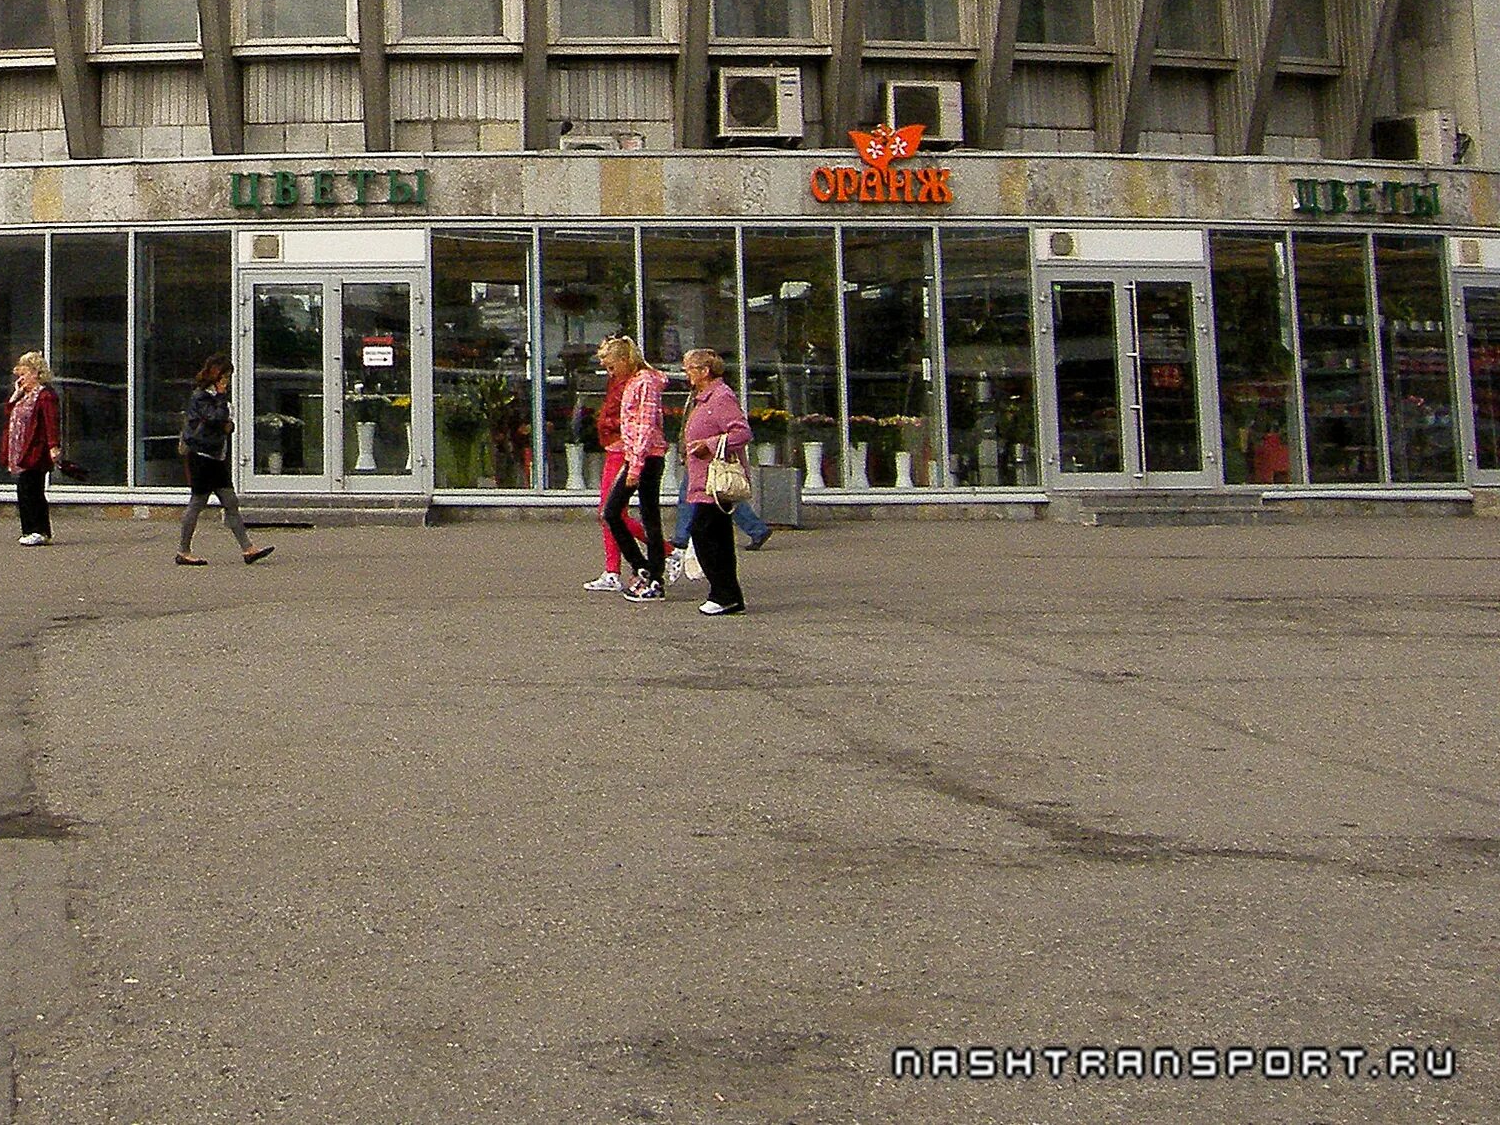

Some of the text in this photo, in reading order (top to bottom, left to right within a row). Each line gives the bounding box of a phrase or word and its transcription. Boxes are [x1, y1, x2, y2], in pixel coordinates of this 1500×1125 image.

[230, 169, 427, 214] ЦВЕТЫ
[810, 165, 954, 204] ОРАНЖ
[1290, 178, 1441, 217] ЦВЕТЫ
